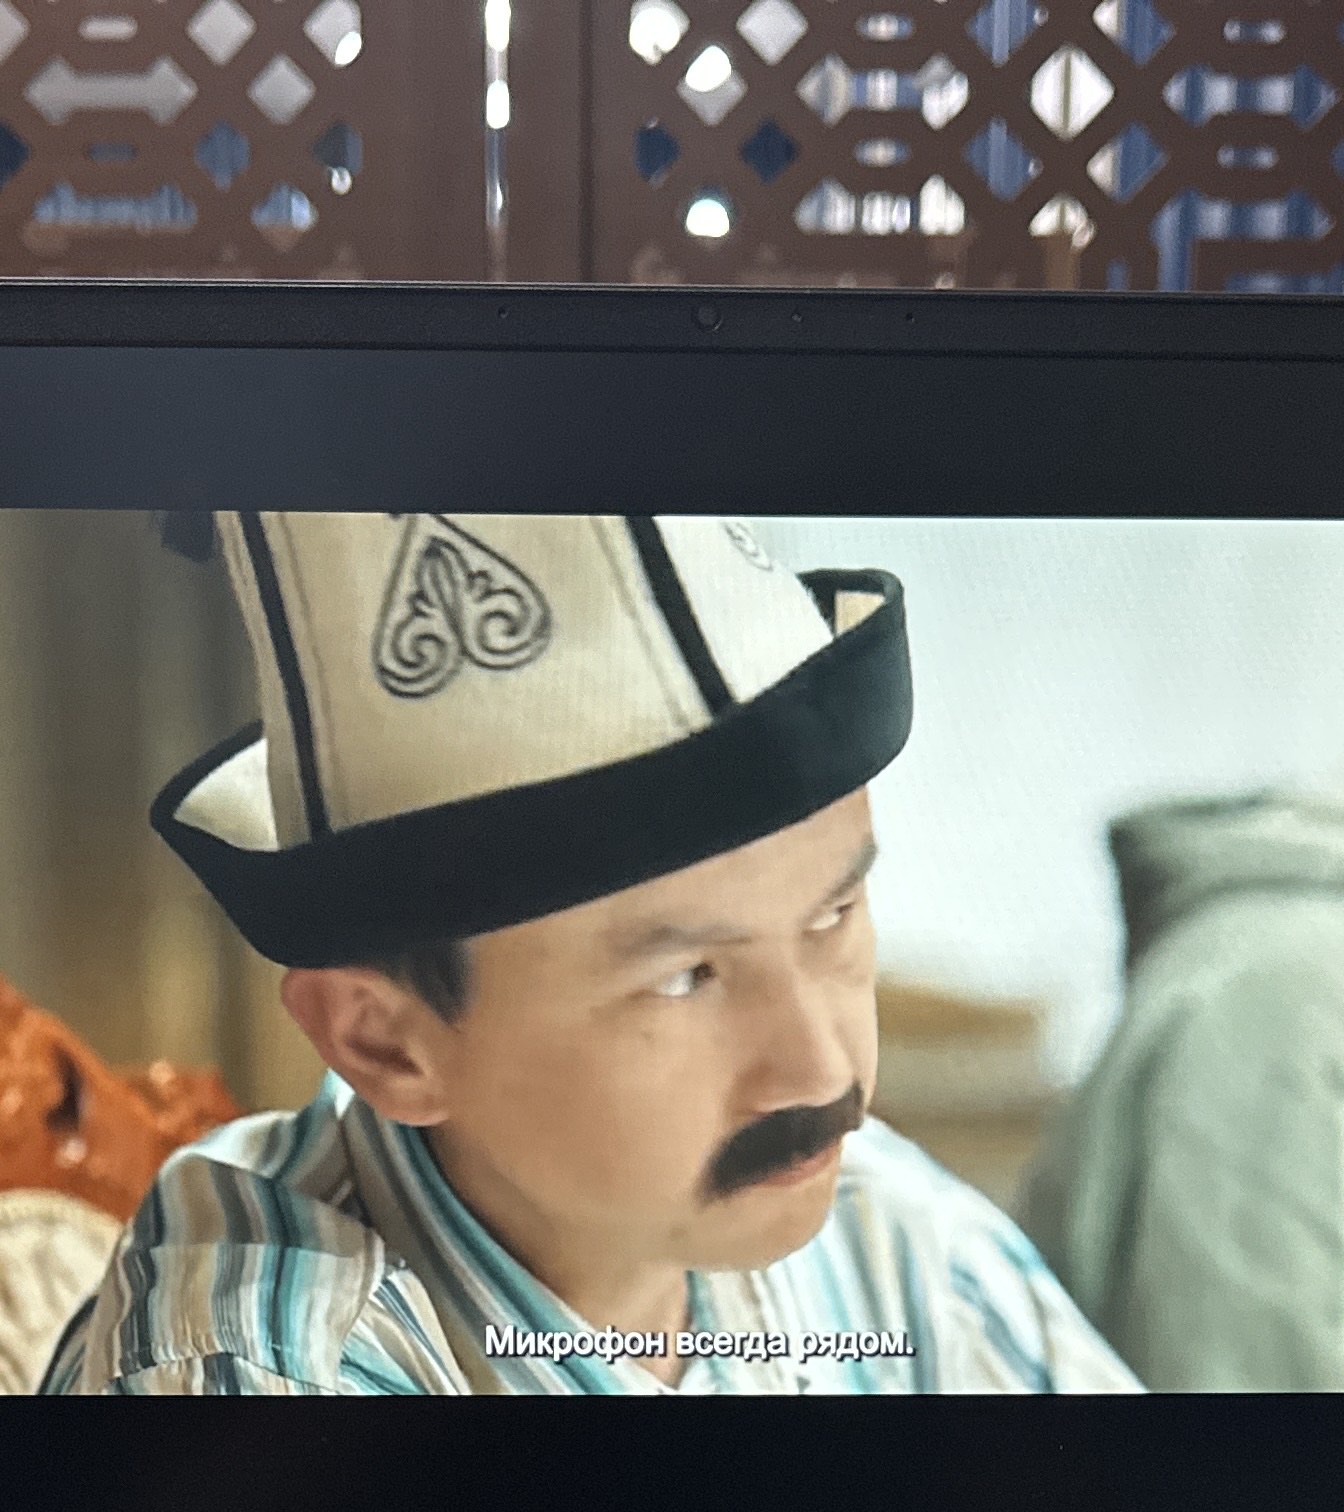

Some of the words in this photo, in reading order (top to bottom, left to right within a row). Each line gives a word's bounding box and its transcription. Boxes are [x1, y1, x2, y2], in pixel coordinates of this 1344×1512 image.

[485, 1324, 666, 1360] Микрофон
[676, 1329, 788, 1358] всегда
[799, 1329, 914, 1361] рядом.
